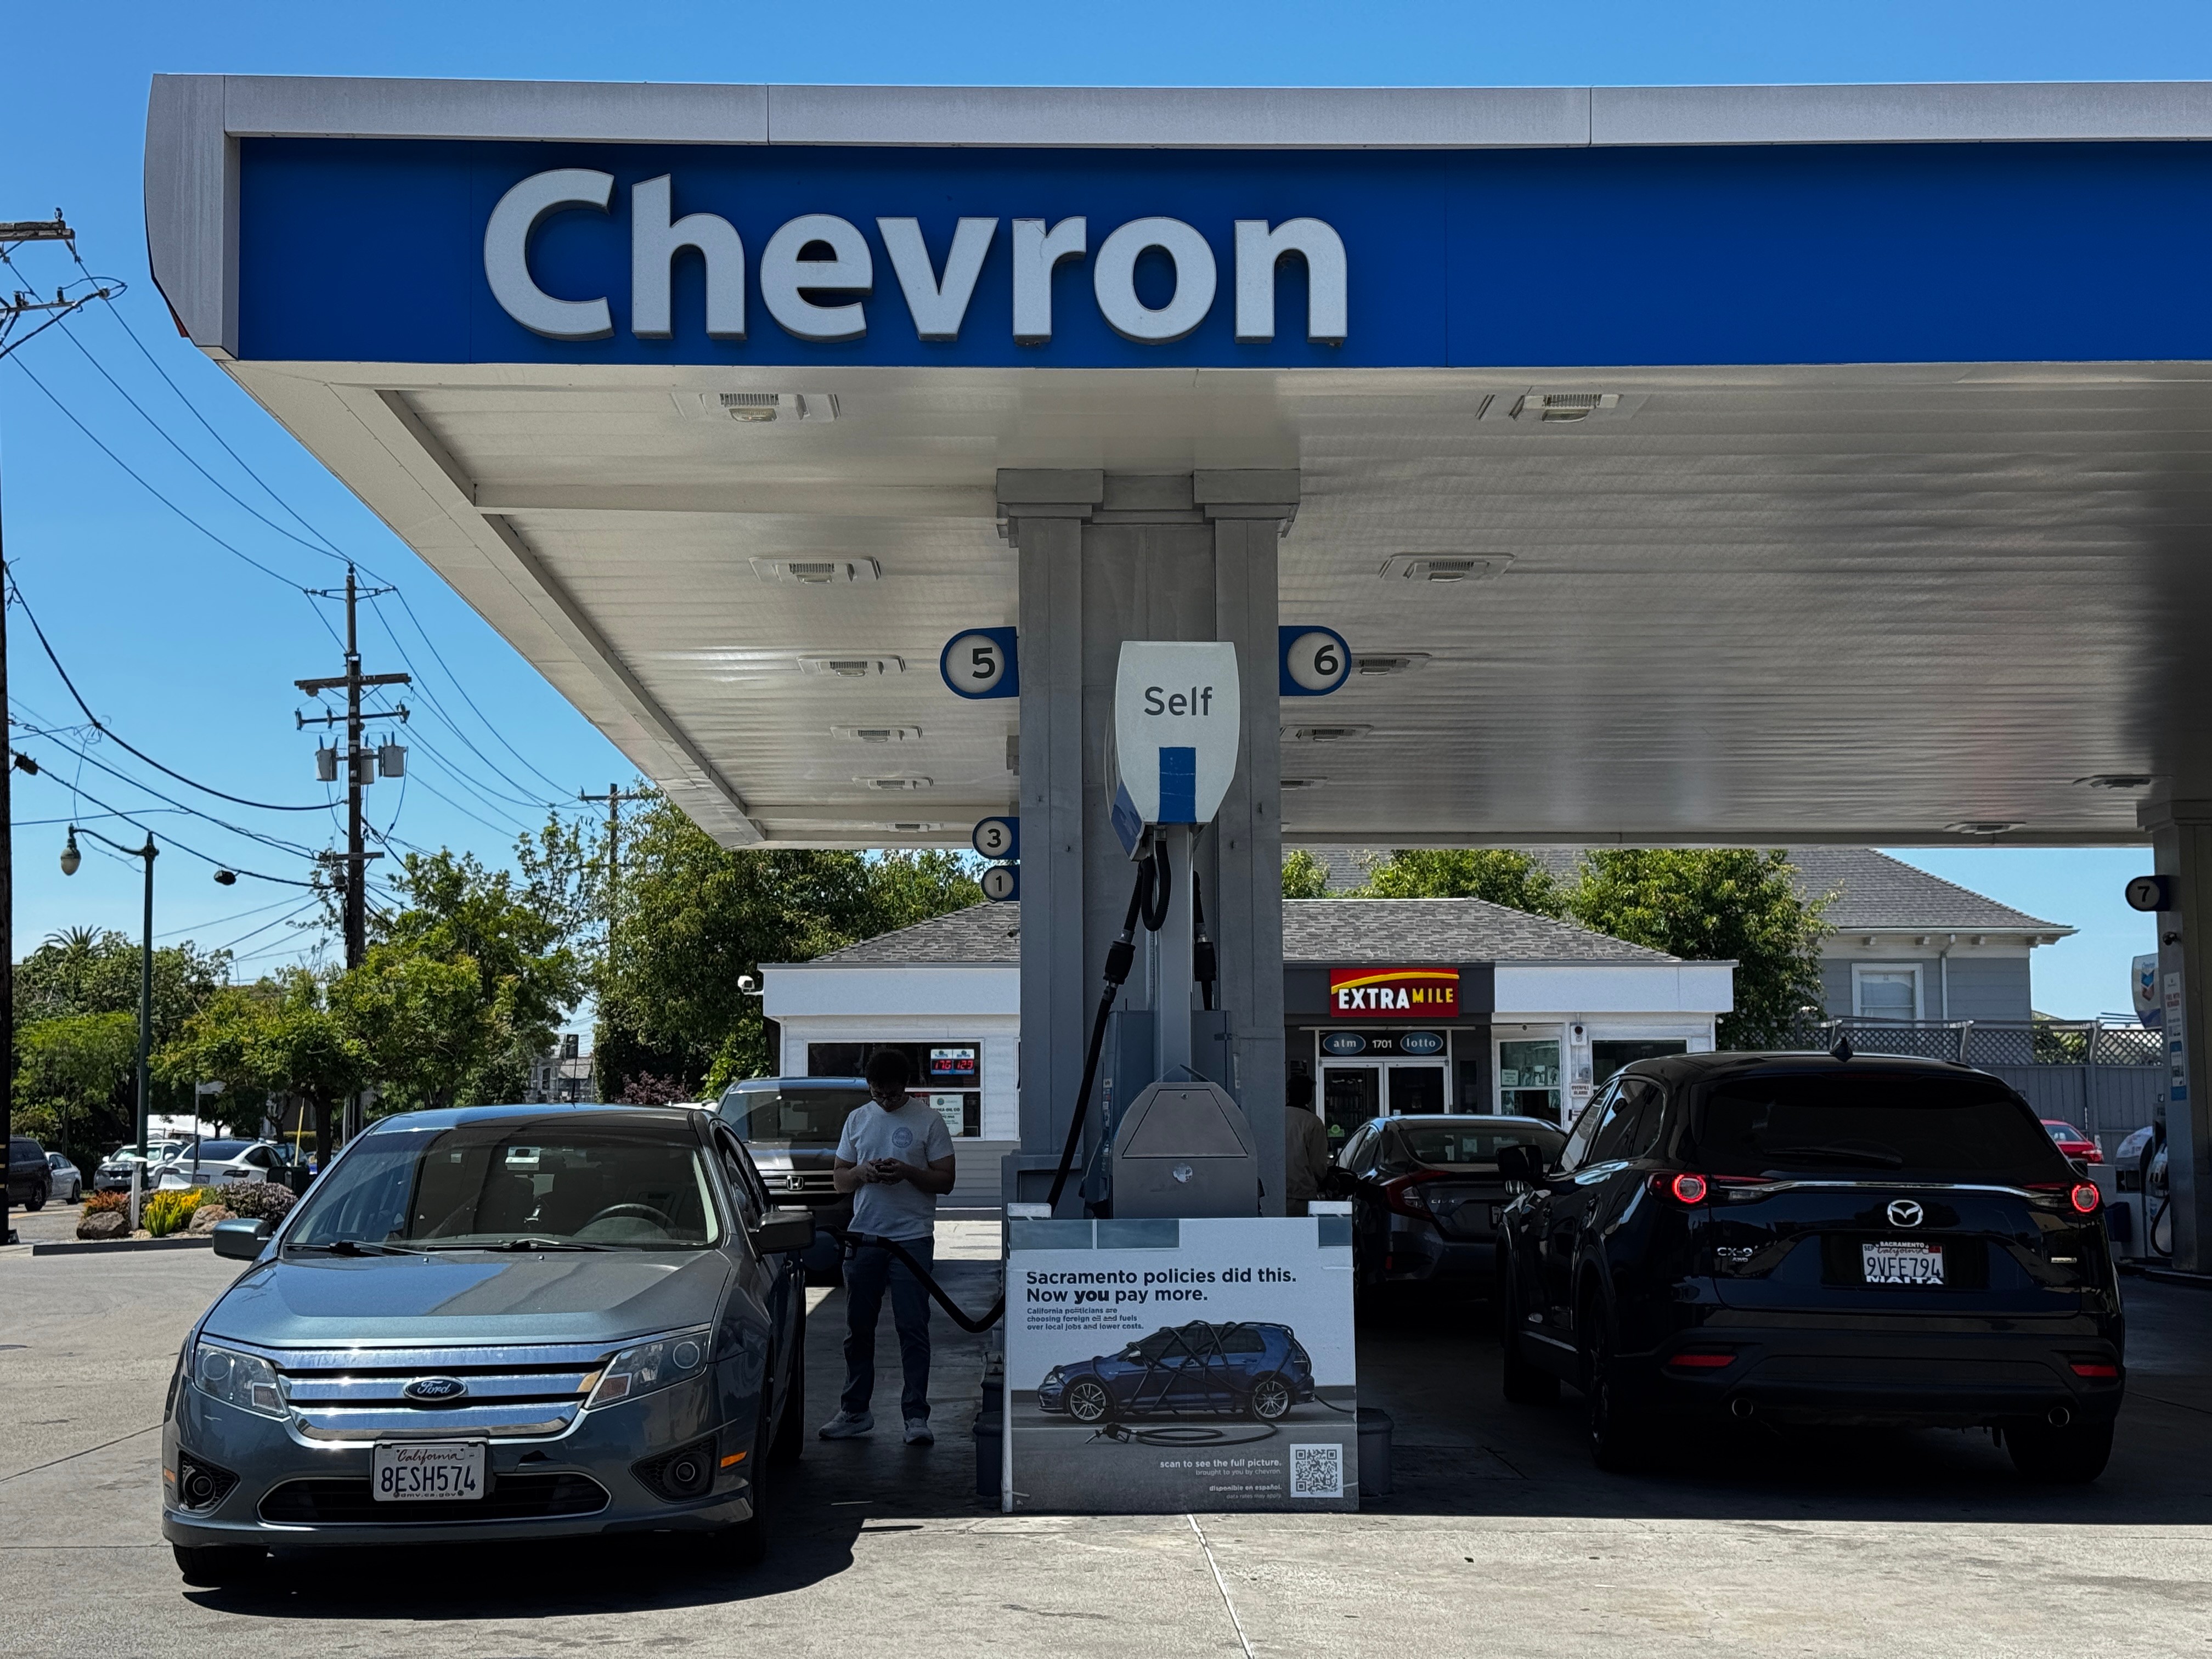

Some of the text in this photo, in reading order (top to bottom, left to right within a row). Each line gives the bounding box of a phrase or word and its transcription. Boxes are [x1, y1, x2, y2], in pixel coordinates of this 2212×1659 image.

[483, 167, 1348, 346] Chevron
[972, 647, 996, 679] 5
[1314, 644, 1339, 675] 6
[1144, 686, 1213, 716] Self
[986, 828, 1002, 848] 3
[995, 875, 1002, 892] 1
[2137, 885, 2150, 902] 7
[1333, 1040, 1357, 1048] atm
[1372, 1040, 1392, 1048] 1701
[1406, 1038, 1436, 1048] lotto
[1717, 1247, 1753, 1257] CX-9
[1866, 1256, 1941, 1277] 9VFE794
[1026, 1267, 1297, 1286] Sacramento policies did this.
[1866, 1276, 1944, 1285] MAITA
[1026, 1288, 1208, 1304] Now you pay more.
[1063, 1315, 1090, 1323] foreign
[417, 1380, 452, 1394] Ford
[397, 1448, 465, 1465] California
[1183, 1460, 1193, 1468] to
[1213, 1459, 1228, 1467] the
[1231, 1458, 1245, 1467] full
[1248, 1458, 1282, 1468] picture.
[381, 1465, 476, 1493] 8ESH574
[1196, 1469, 1222, 1477] brought
